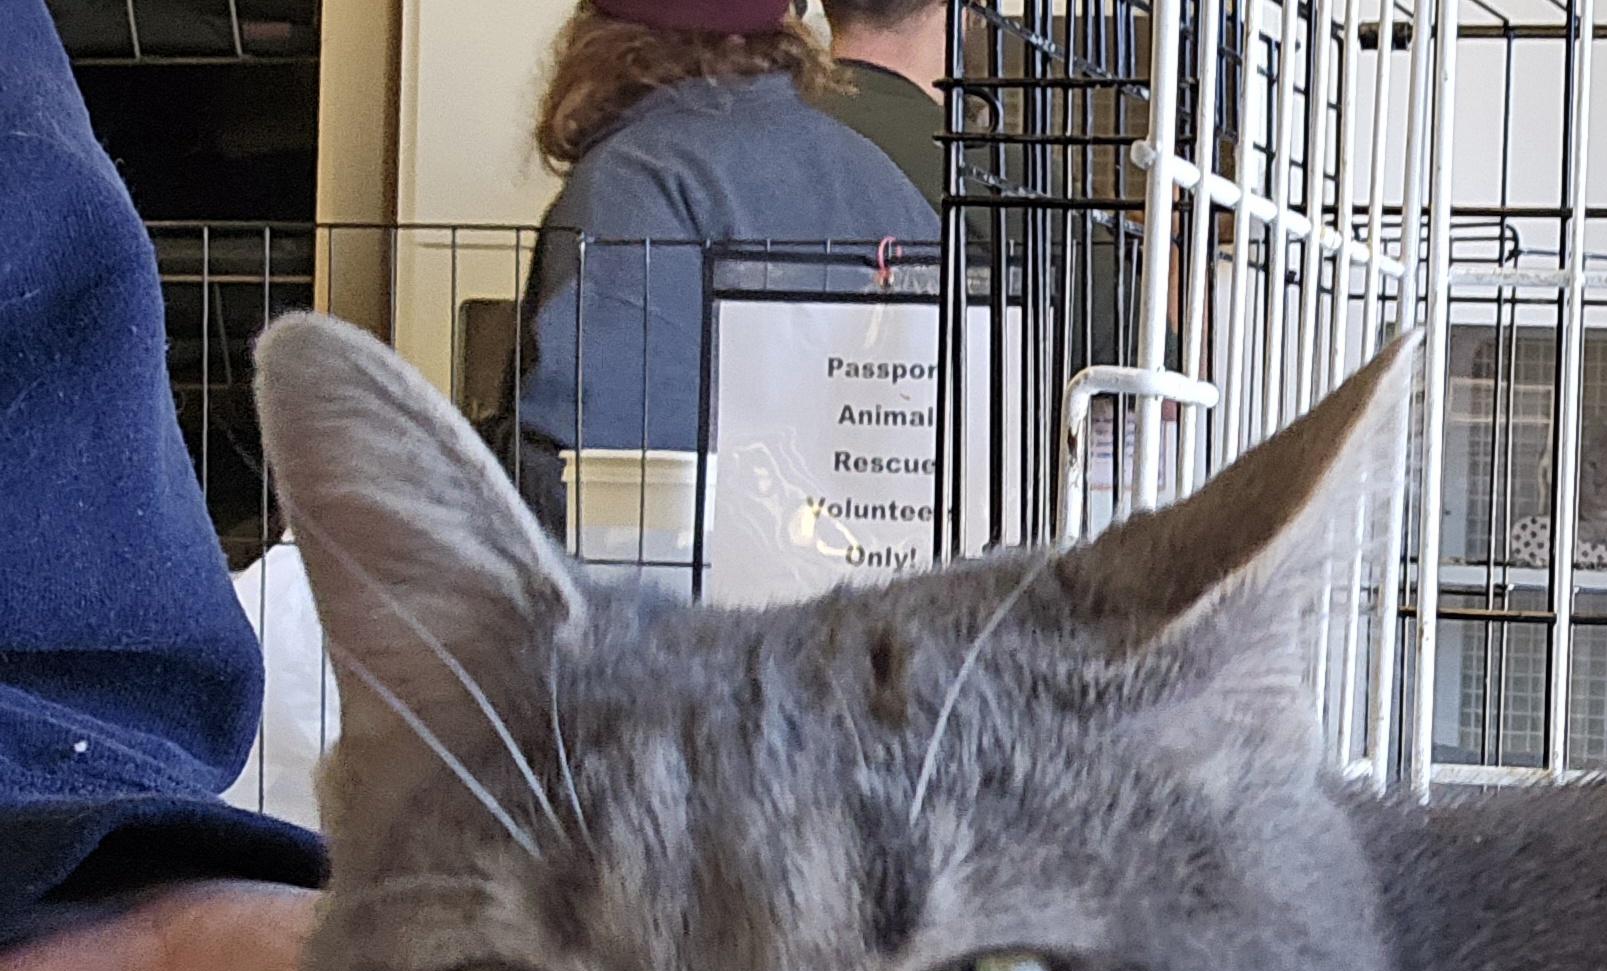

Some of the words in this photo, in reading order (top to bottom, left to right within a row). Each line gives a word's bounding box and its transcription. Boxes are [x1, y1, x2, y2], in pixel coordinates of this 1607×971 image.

[827, 357, 938, 385] Passpor
[838, 404, 933, 427] Animal
[834, 451, 936, 475] Rescue
[806, 497, 952, 521] Voluntee
[846, 545, 917, 573] Only!
